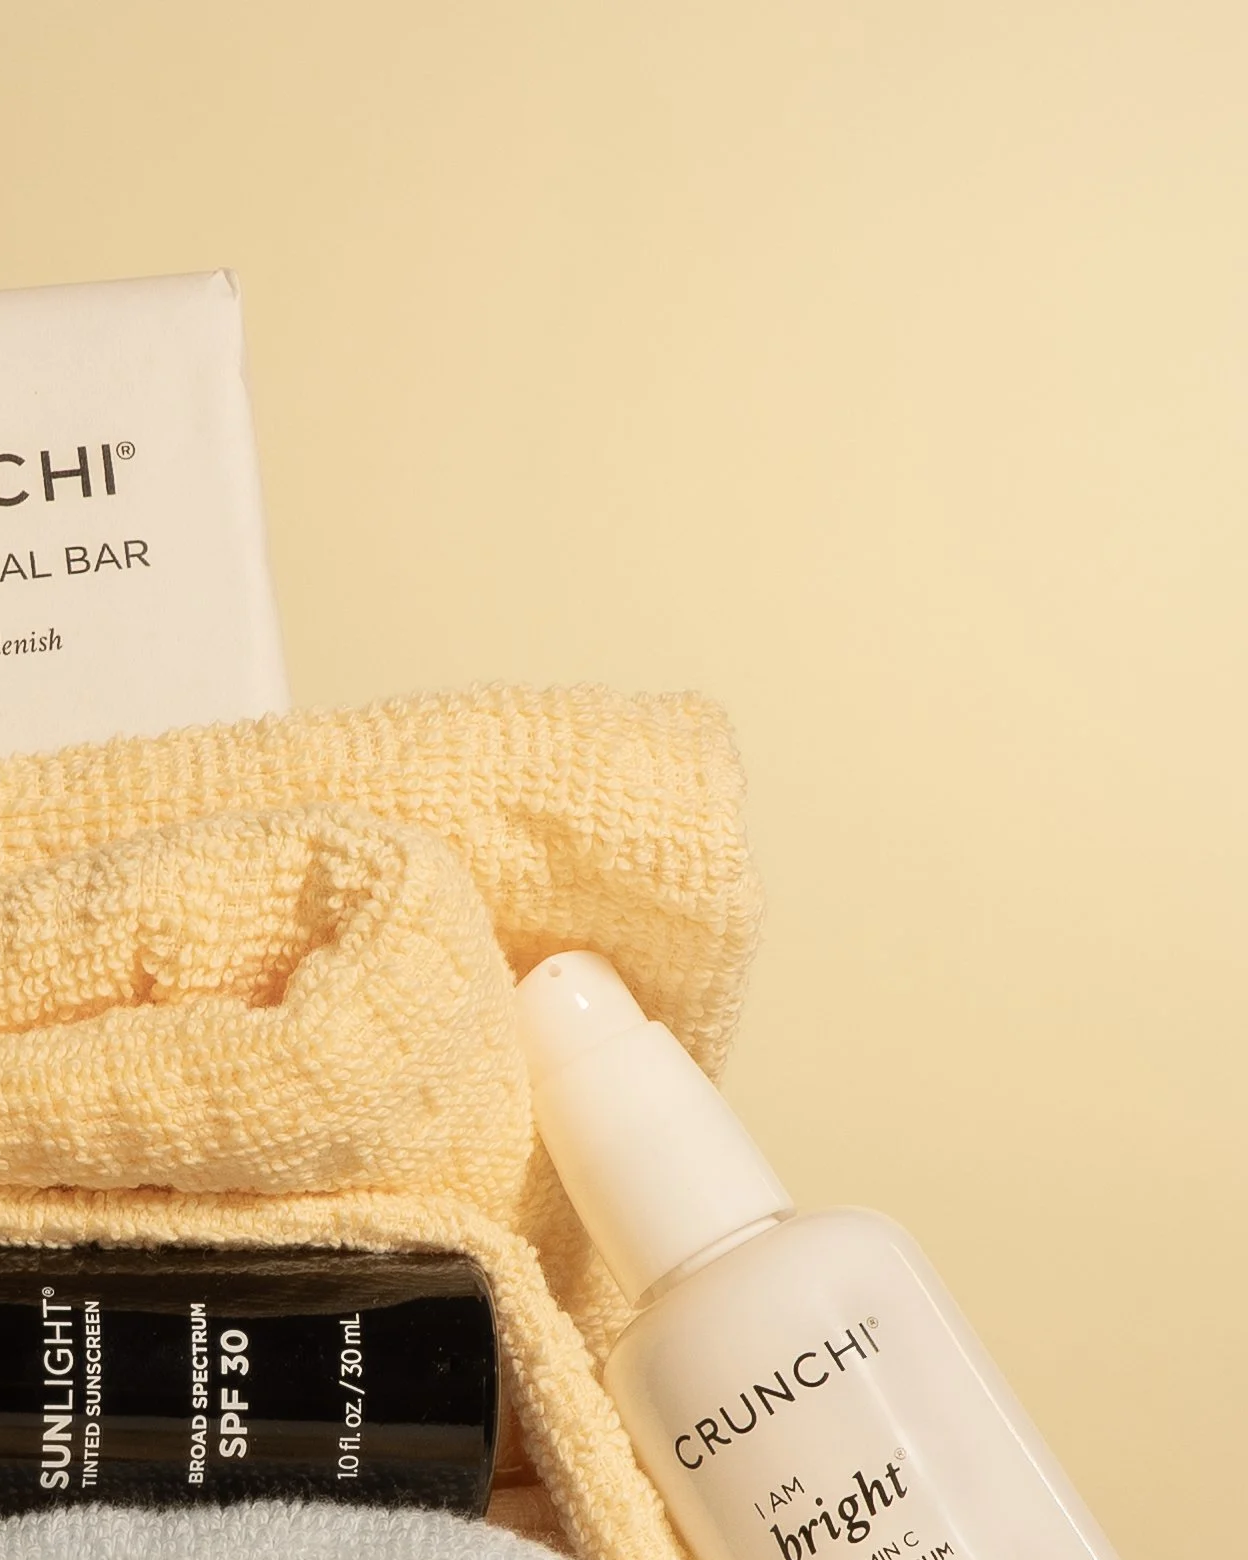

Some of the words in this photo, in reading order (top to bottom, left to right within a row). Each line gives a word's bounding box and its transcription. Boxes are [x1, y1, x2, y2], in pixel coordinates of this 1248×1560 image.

[64, 539, 150, 575] BAR
[339, 1313, 360, 1343] mL
[84, 1300, 100, 1416] SUNSCREEN
[190, 1303, 208, 1408] SPECTRUM
[220, 1329, 249, 1375] 30
[340, 1349, 362, 1377] 30
[338, 1380, 364, 1394] /
[219, 1388, 248, 1458] SPF
[345, 1398, 361, 1427] oz.
[82, 1423, 100, 1487] TINTED
[188, 1414, 207, 1483] BROAD
[339, 1432, 360, 1450] fl.
[337, 1455, 358, 1479] 1.0
[754, 1502, 765, 1519] I
[770, 1476, 804, 1513] AM
[903, 1531, 919, 1547] C
